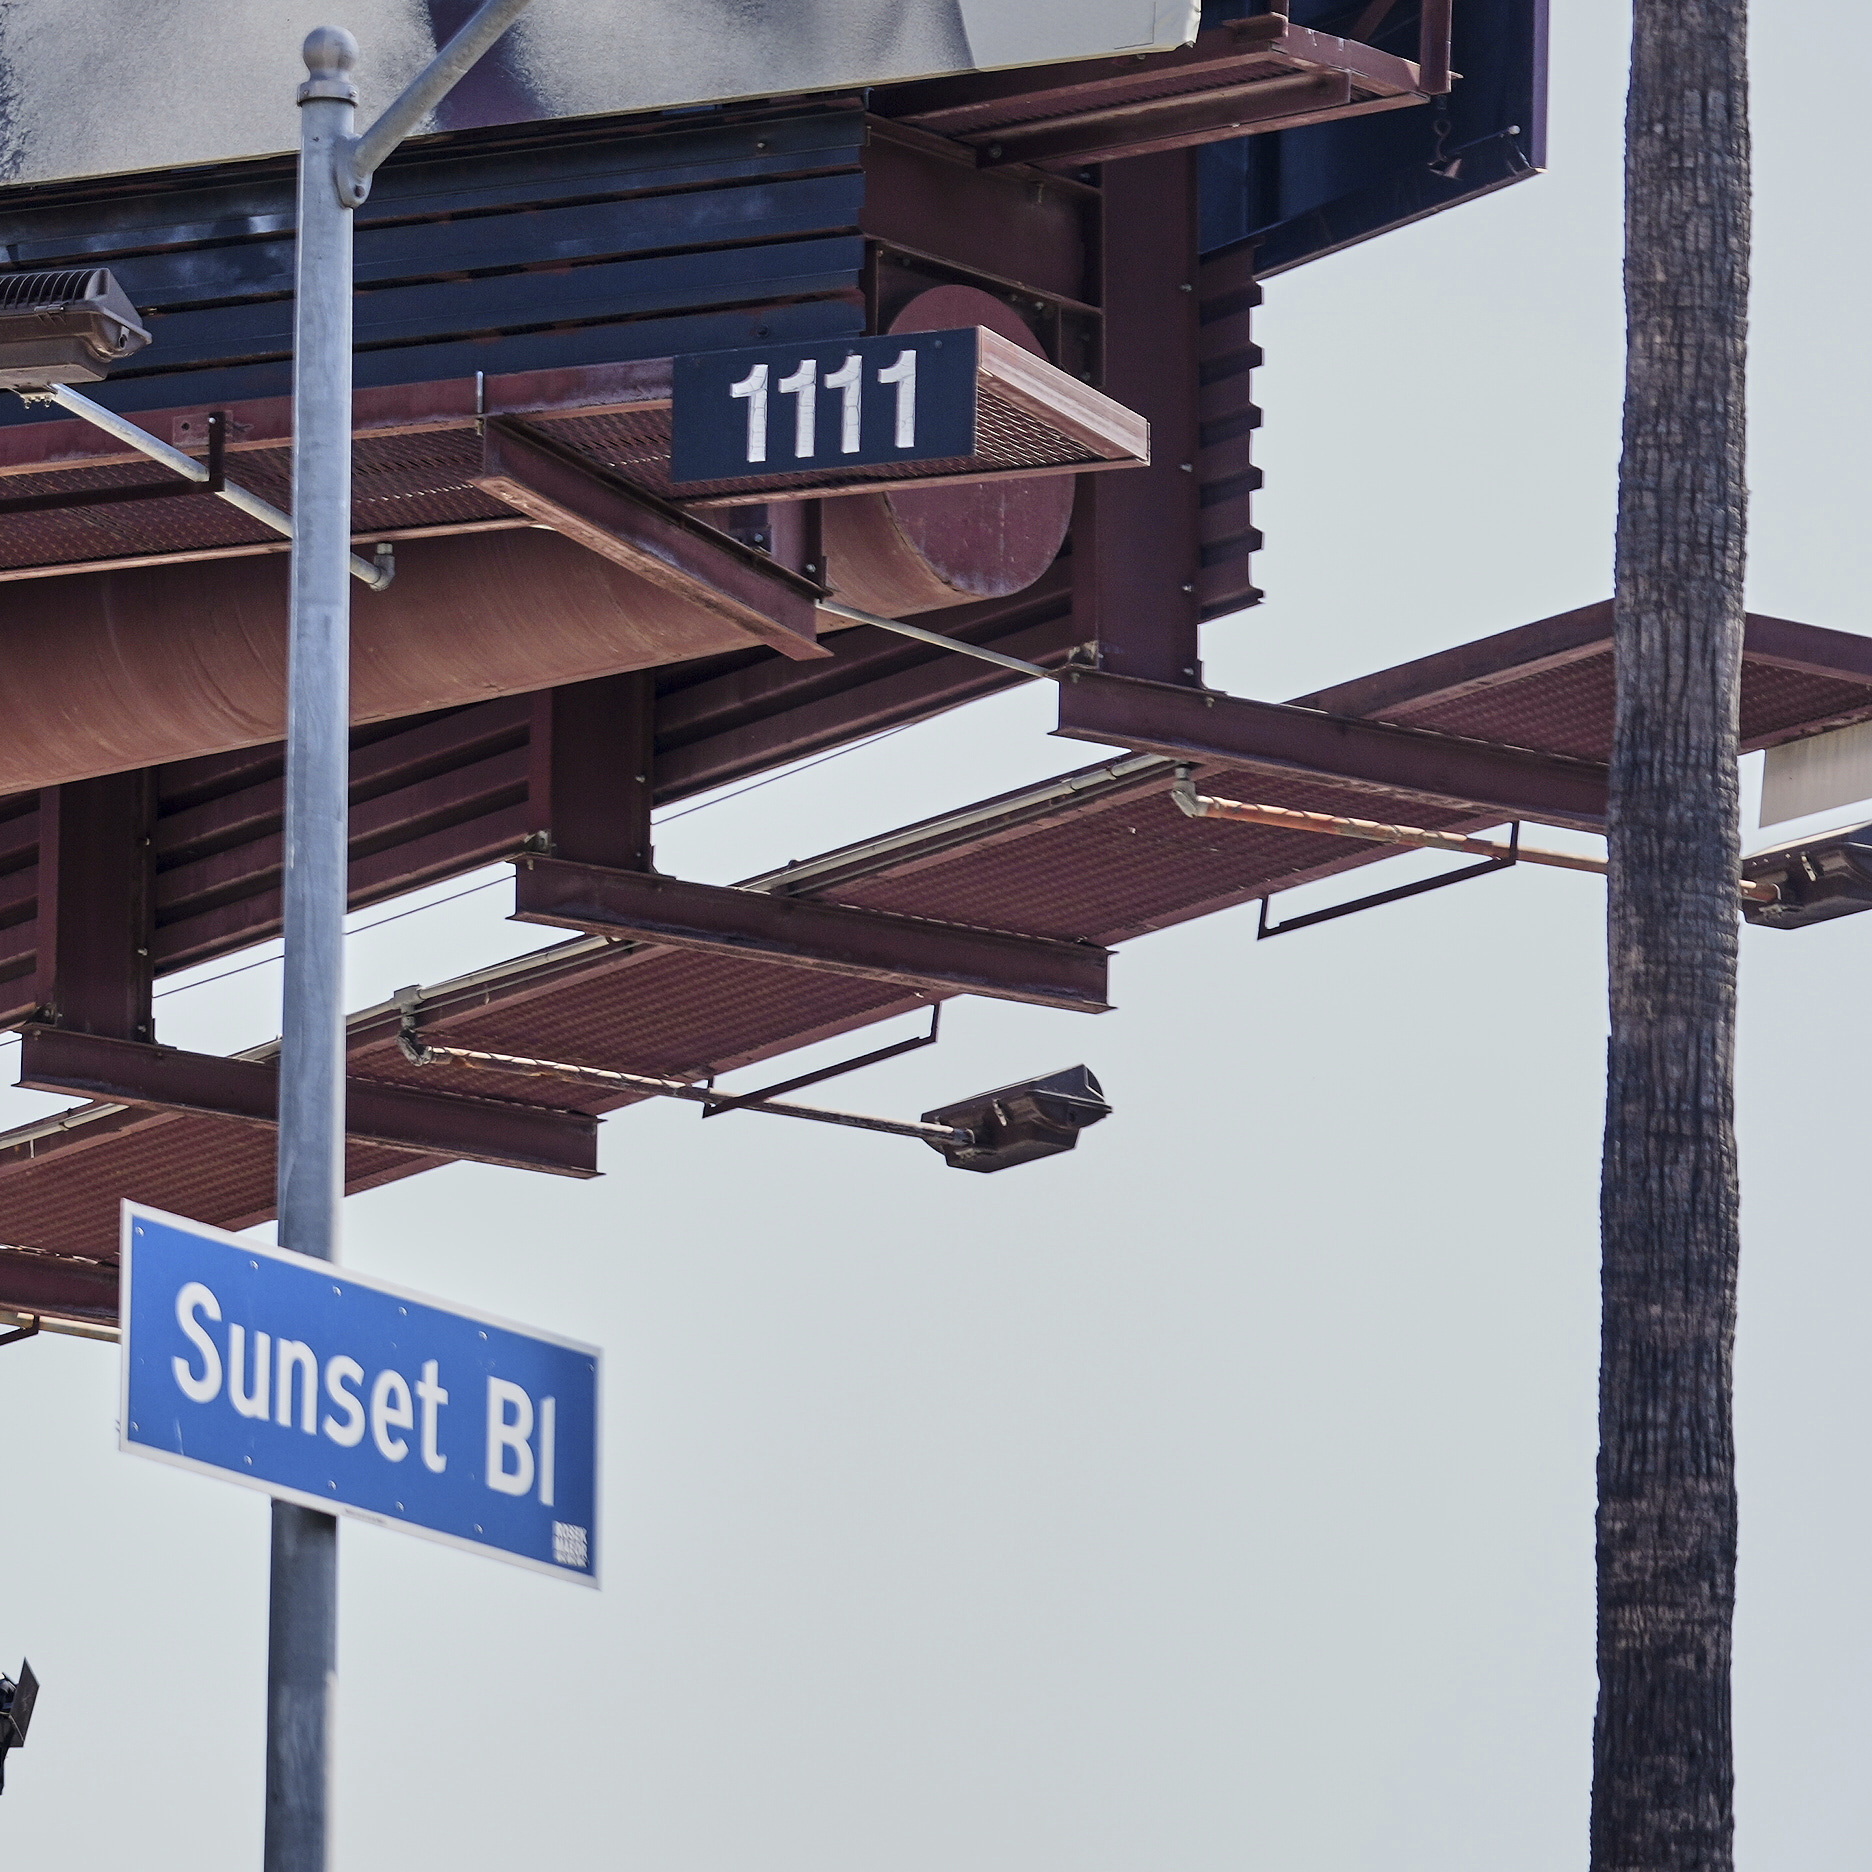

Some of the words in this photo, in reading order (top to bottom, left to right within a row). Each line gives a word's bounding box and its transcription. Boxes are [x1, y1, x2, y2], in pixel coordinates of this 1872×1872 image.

[729, 349, 918, 464] 1111
[172, 1281, 450, 1474] Sunset
[486, 1375, 556, 1507] Bl
